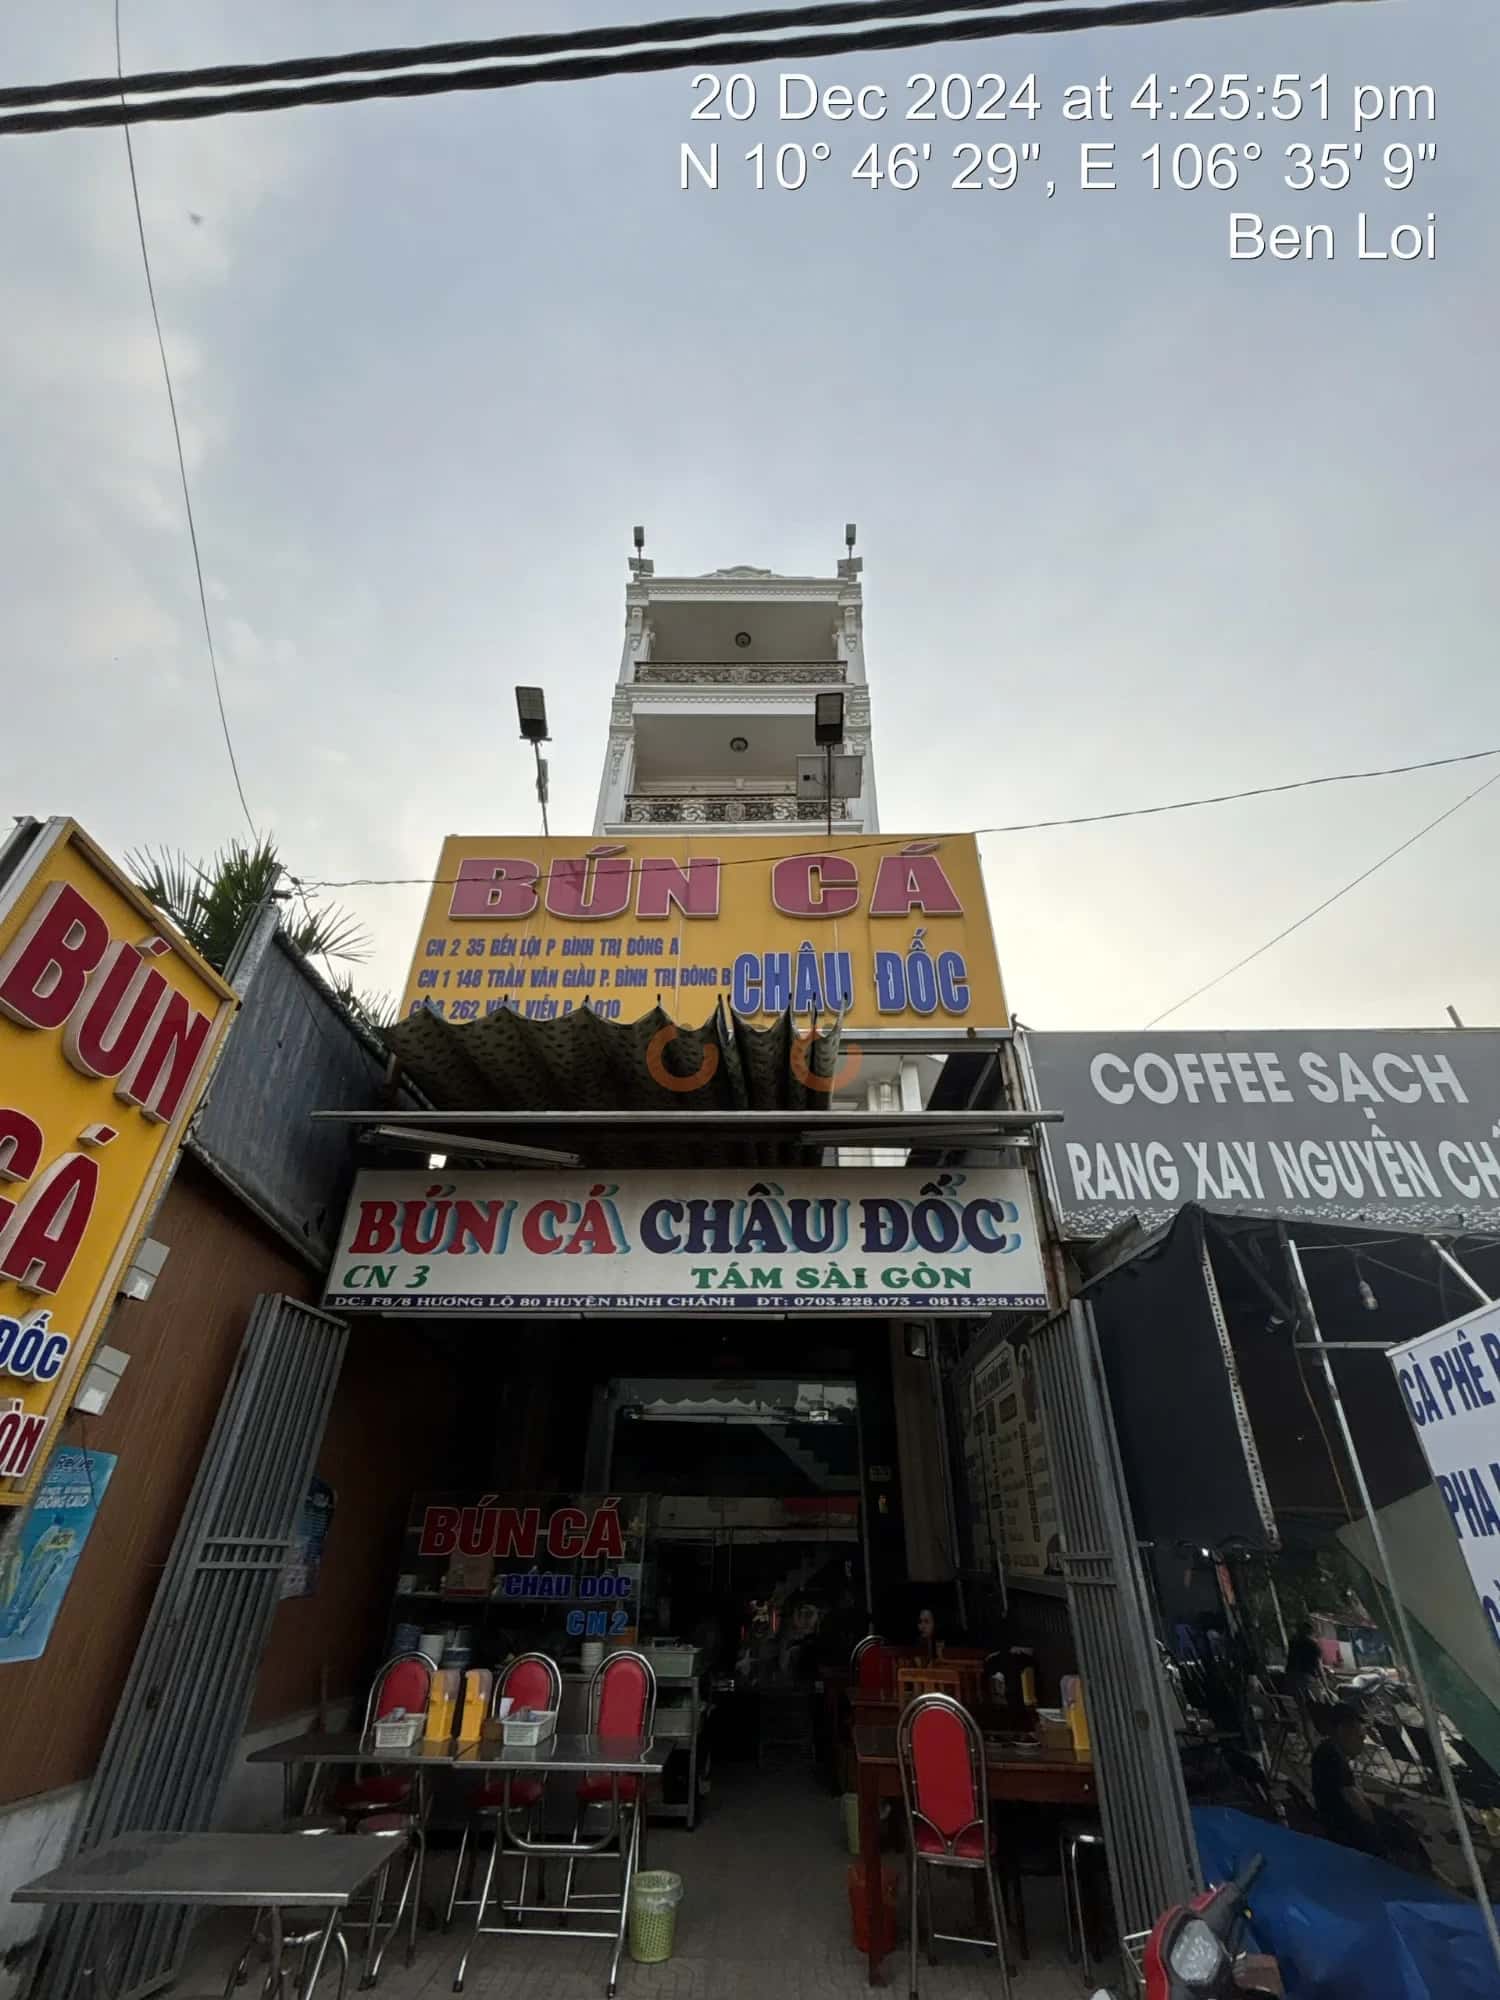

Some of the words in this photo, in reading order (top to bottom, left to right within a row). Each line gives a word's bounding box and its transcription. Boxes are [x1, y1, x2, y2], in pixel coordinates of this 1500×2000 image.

[448, 844, 720, 921] BÚN
[771, 842, 965, 919] CÁ
[425, 938, 447, 957] CN
[449, 938, 462, 957] 2
[466, 938, 486, 957] 35
[669, 937, 679, 956] A
[731, 939, 855, 1015] CHÂU
[873, 928, 972, 1016] ĐỐC
[0, 881, 213, 1125] BÚN
[417, 968, 440, 989] CN
[443, 969, 452, 988] 1
[721, 967, 732, 987] B
[449, 1000, 480, 1020] 262
[1090, 1052, 1295, 1105] COFFEE
[1300, 1052, 1469, 1119] SẠCH
[1065, 1140, 1180, 1201] RANG
[1183, 1140, 1265, 1201] XAY
[348, 1183, 512, 1255] BÚN
[522, 1183, 628, 1255] CÁ
[640, 1182, 847, 1254] CHÂU
[858, 1174, 1018, 1254] ĐỐC
[343, 1265, 397, 1289] CN
[405, 1265, 431, 1289] 3
[519, 1296, 541, 1307] 80
[691, 1261, 784, 1289] TÁM
[795, 1261, 869, 1289] SÀI
[880, 1261, 972, 1289] GÒN
[1429, 1328, 1497, 1417] PHÊ
[418, 1494, 540, 1558] BÚN
[548, 1497, 625, 1559] CÁ
[566, 1609, 608, 1636] CN
[608, 1609, 630, 1636] 2
